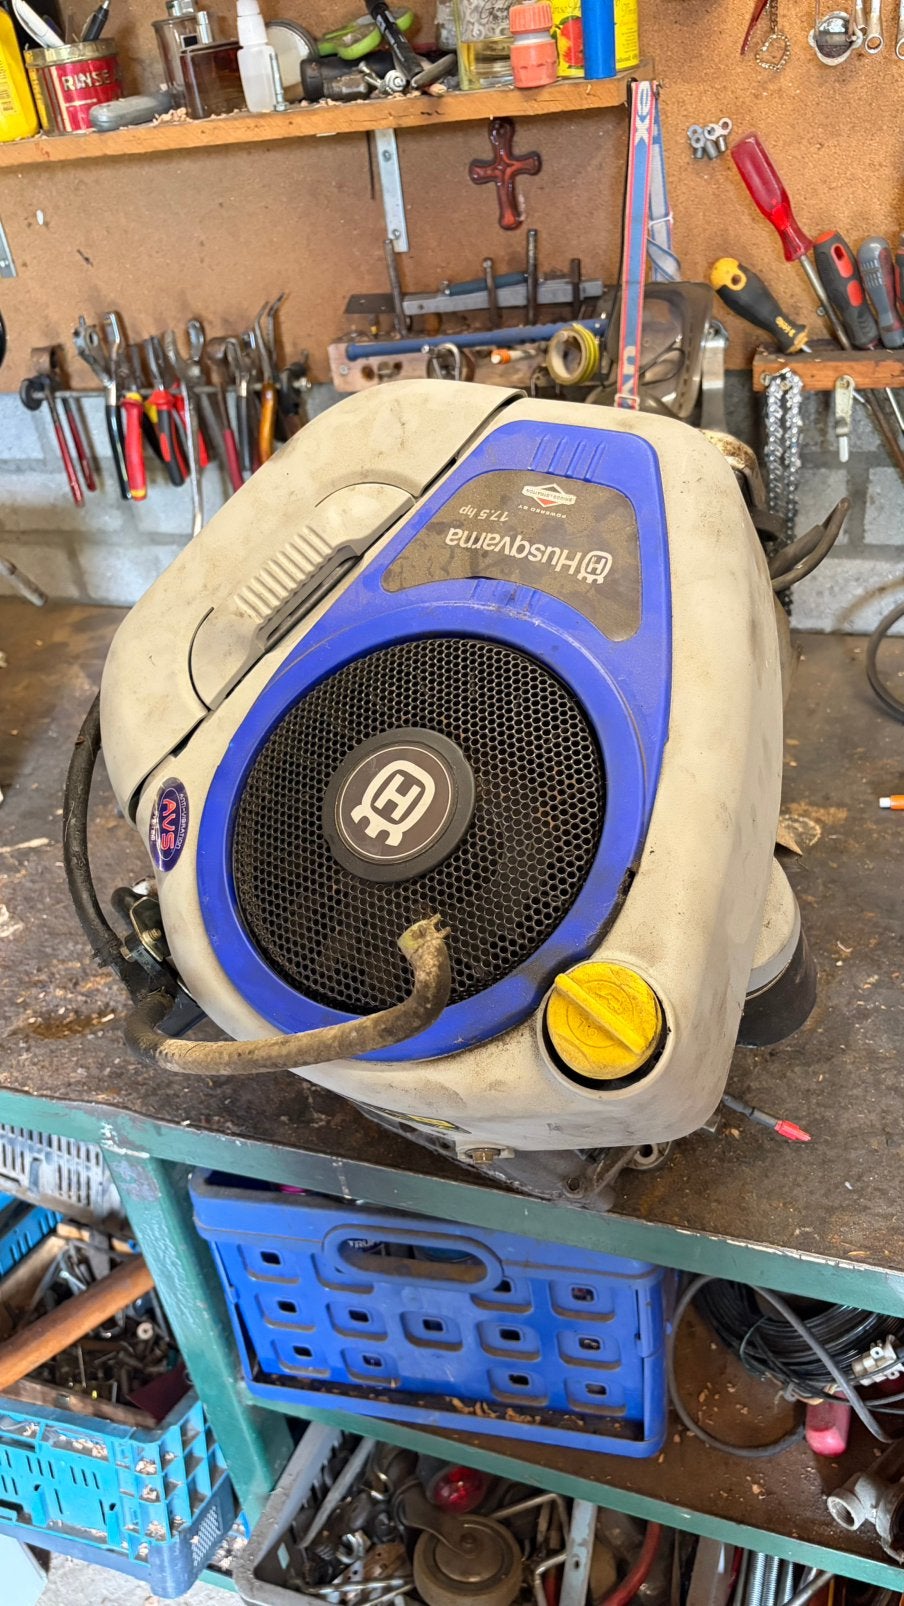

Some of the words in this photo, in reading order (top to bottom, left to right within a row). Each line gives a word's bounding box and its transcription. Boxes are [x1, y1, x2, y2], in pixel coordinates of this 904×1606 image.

[61, 69, 111, 91] RINSE
[459, 504, 477, 517] hp
[478, 509, 509, 522] 17.5
[530, 507, 567, 517] POWERED
[445, 527, 582, 574] Husqvarna
[162, 799, 176, 850] AVS
